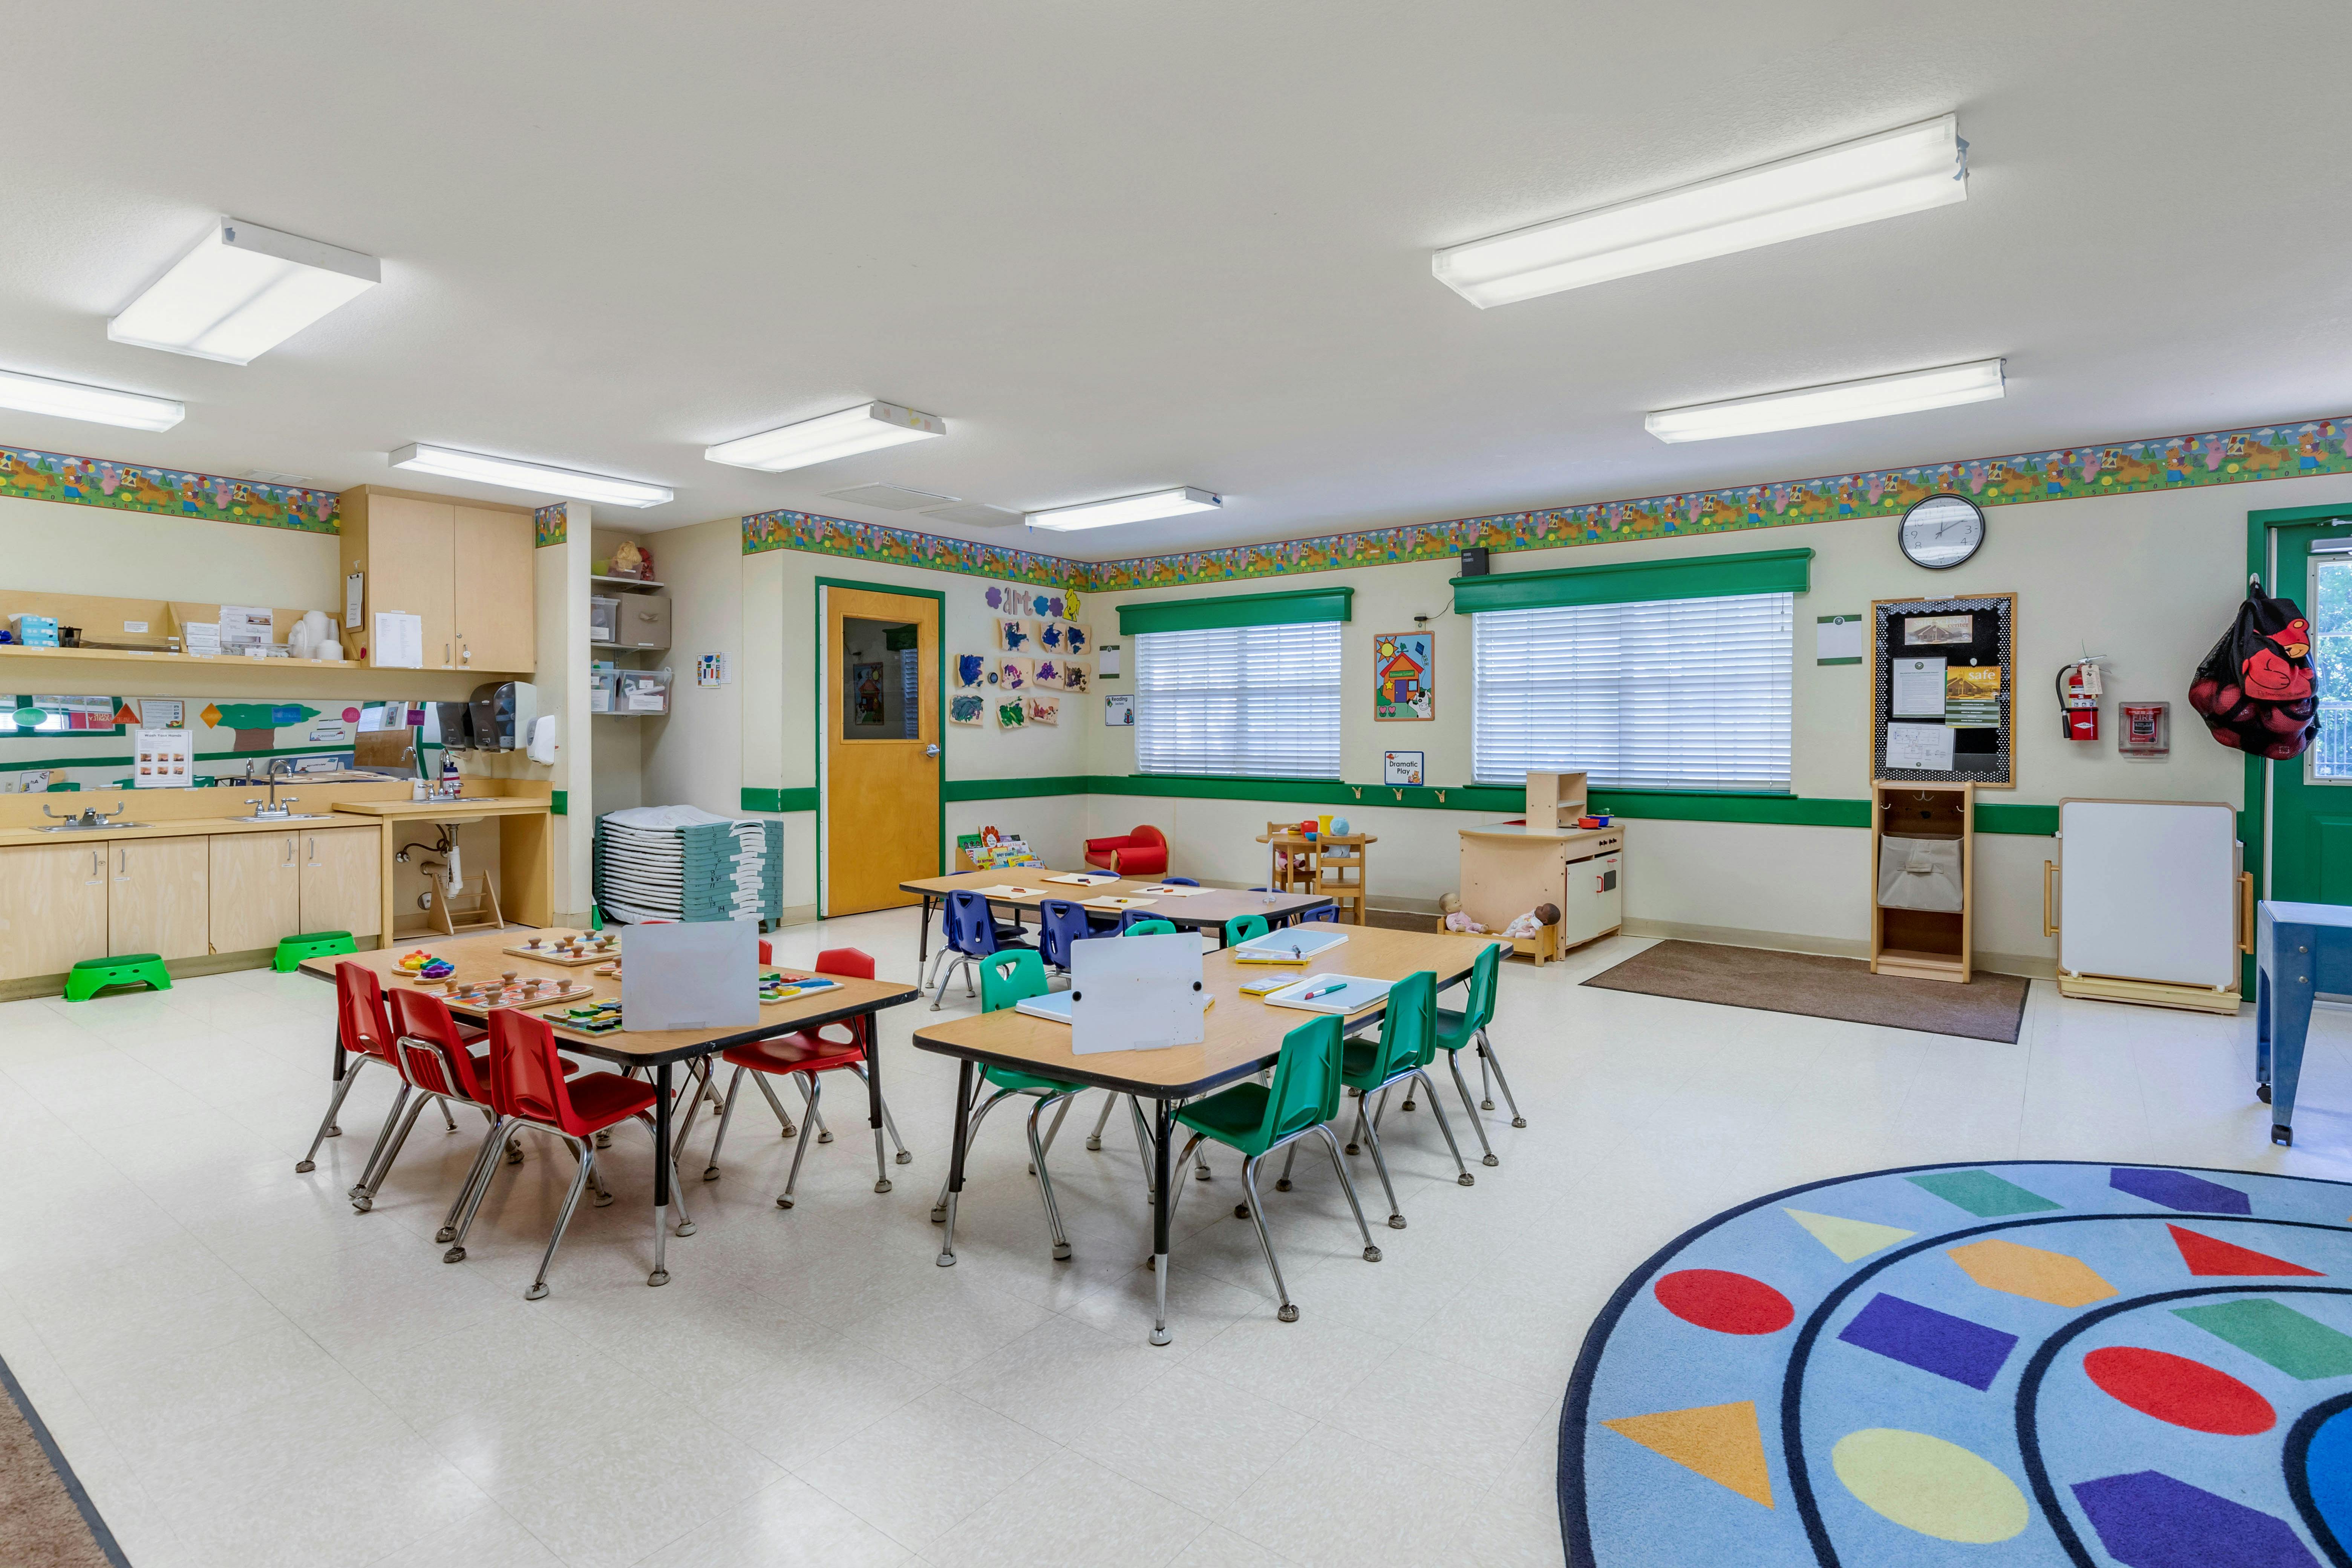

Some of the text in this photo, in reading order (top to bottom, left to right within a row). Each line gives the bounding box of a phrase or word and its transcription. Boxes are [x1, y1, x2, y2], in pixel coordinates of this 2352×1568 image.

[1965, 525, 1972, 534] 3
[1003, 587, 1034, 616] art
[1969, 670, 1995, 680] safe
